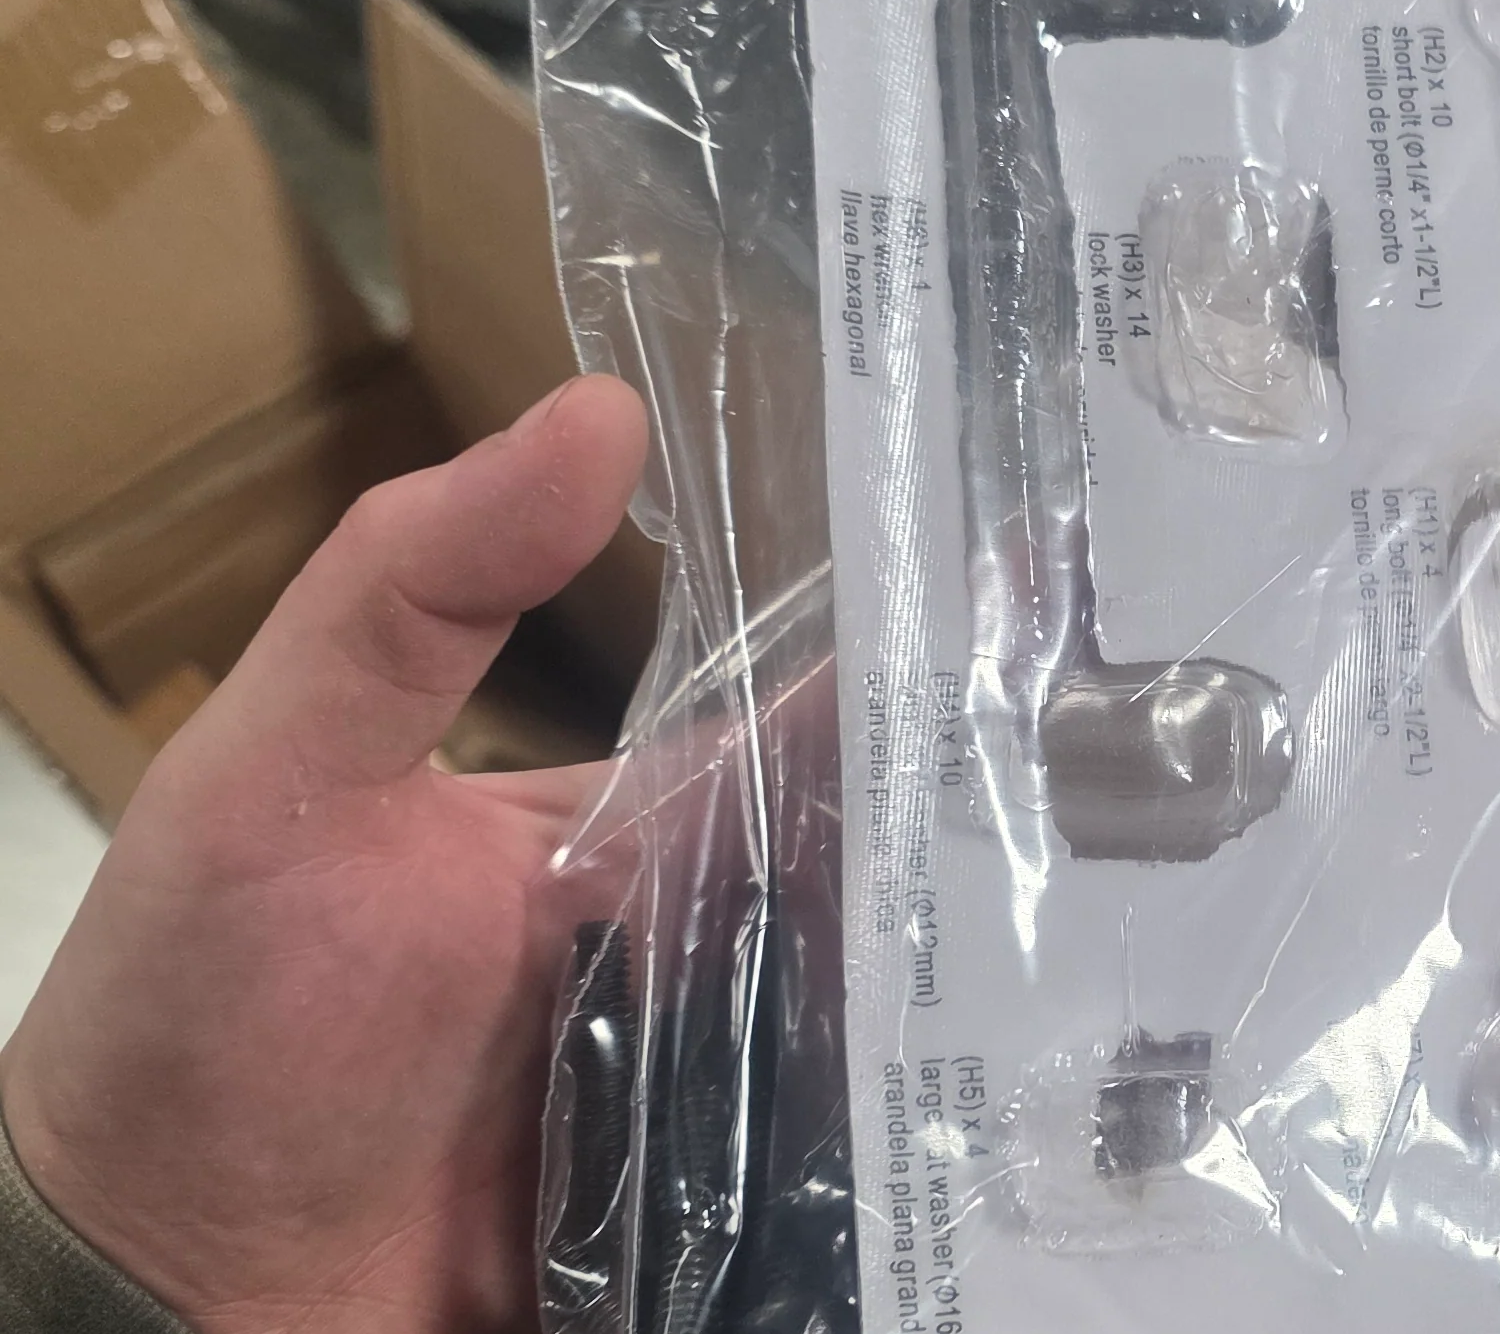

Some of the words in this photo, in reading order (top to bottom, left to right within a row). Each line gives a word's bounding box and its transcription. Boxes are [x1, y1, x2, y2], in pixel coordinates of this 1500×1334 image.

[1361, 26, 1388, 101] tornillo
[1392, 26, 1417, 81] short
[1418, 27, 1447, 73] (H2)
[1398, 87, 1421, 127] bolt
[1428, 79, 1444, 91] x
[1369, 107, 1391, 134] de
[1430, 103, 1453, 127] 10
[840, 189, 863, 245] llave
[870, 195, 893, 237] hex
[1379, 209, 1404, 265] corto
[1088, 232, 1112, 278] lock
[1115, 233, 1147, 282] (H3)
[842, 252, 872, 377] hexagonal
[1125, 287, 1144, 300] x
[1092, 284, 1119, 367] washer
[1127, 312, 1152, 338] 14
[1350, 488, 1377, 566] tornillo
[1380, 489, 1404, 534] long
[1408, 487, 1439, 536] (H1)
[1420, 543, 1437, 555] x
[1422, 564, 1443, 578] 4
[1358, 573, 1381, 599] de
[865, 671, 894, 781] arandela
[941, 731, 958, 744] x
[939, 758, 963, 787] 10
[916, 1058, 946, 1124] large
[951, 1056, 987, 1111] (H5)
[884, 1062, 916, 1175] arandela
[962, 1117, 981, 1132] x
[926, 1128, 954, 1171] at
[965, 1143, 990, 1159] 4
[886, 1182, 918, 1252] plana
[928, 1176, 958, 1269] washer
